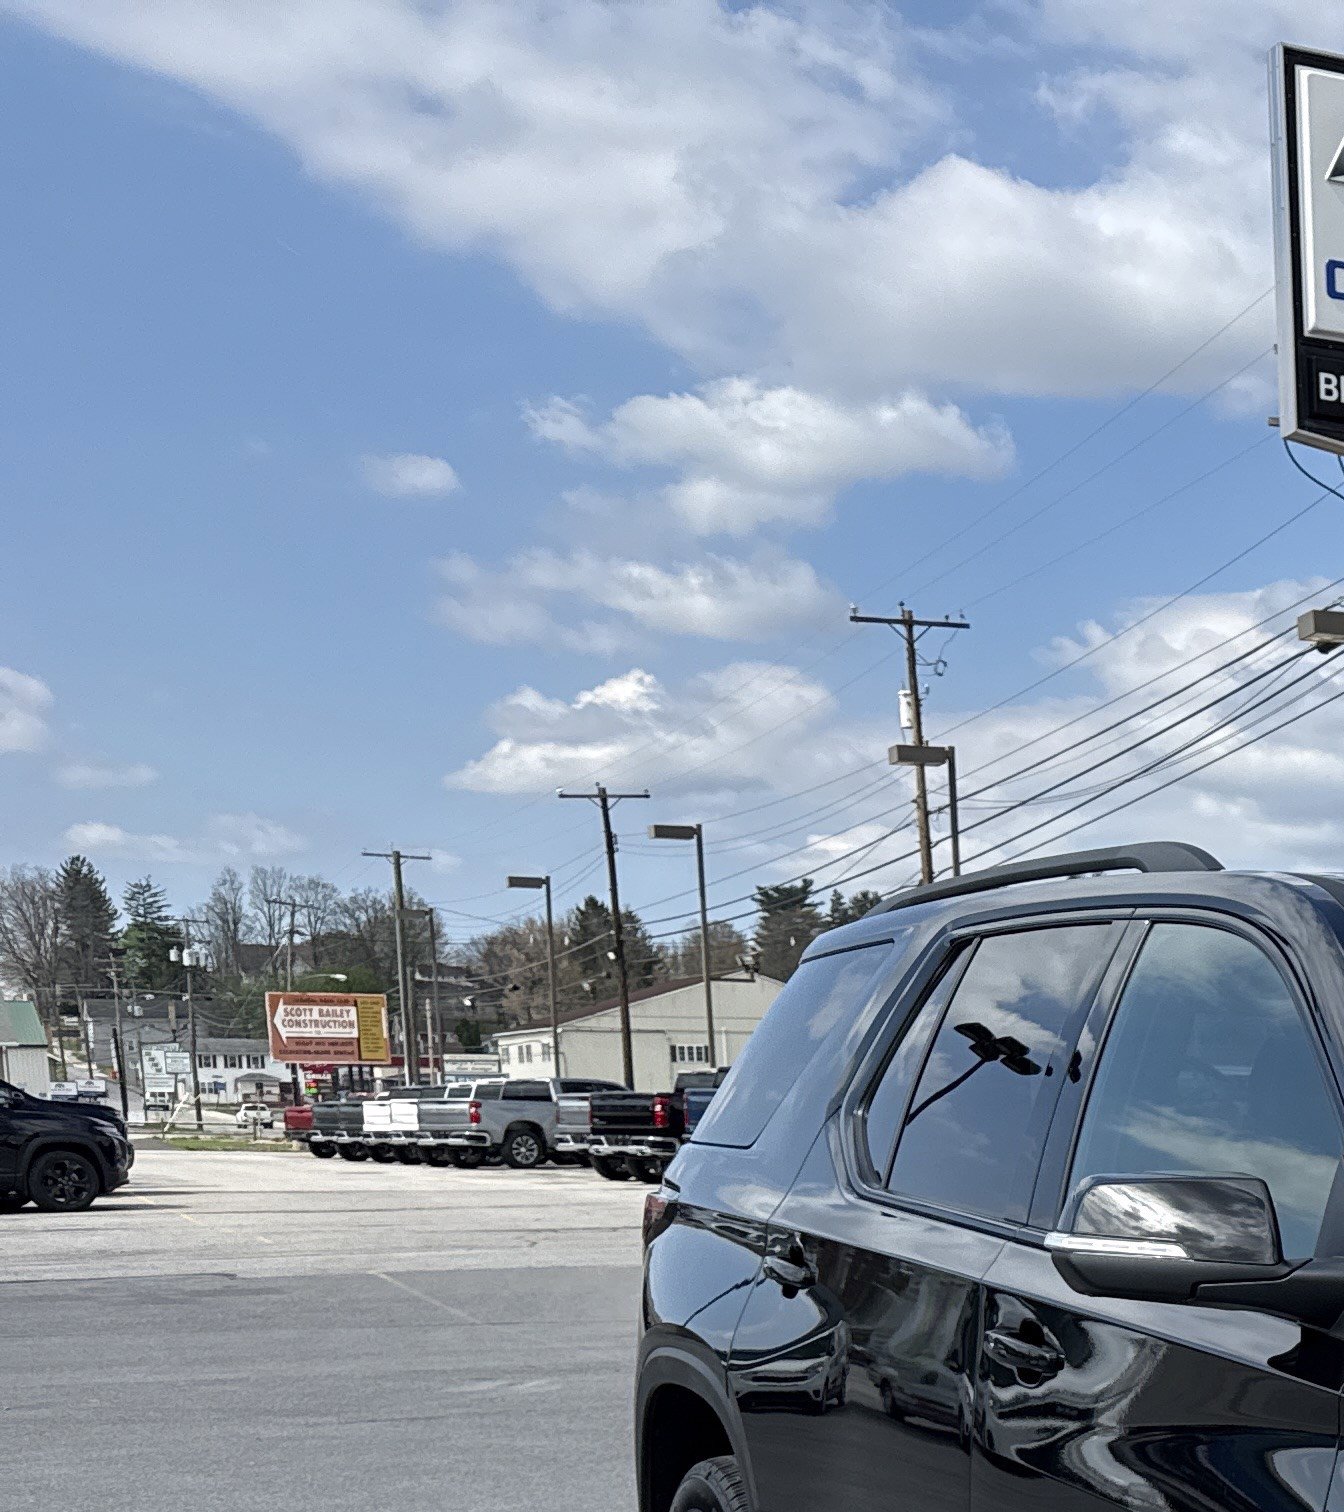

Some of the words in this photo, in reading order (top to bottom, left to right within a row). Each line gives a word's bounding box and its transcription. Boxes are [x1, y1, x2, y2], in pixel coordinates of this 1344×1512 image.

[283, 1007, 314, 1018] SCOTT
[318, 1008, 352, 1019] BAILEY
[281, 1019, 355, 1029] CONSTRUCTION
